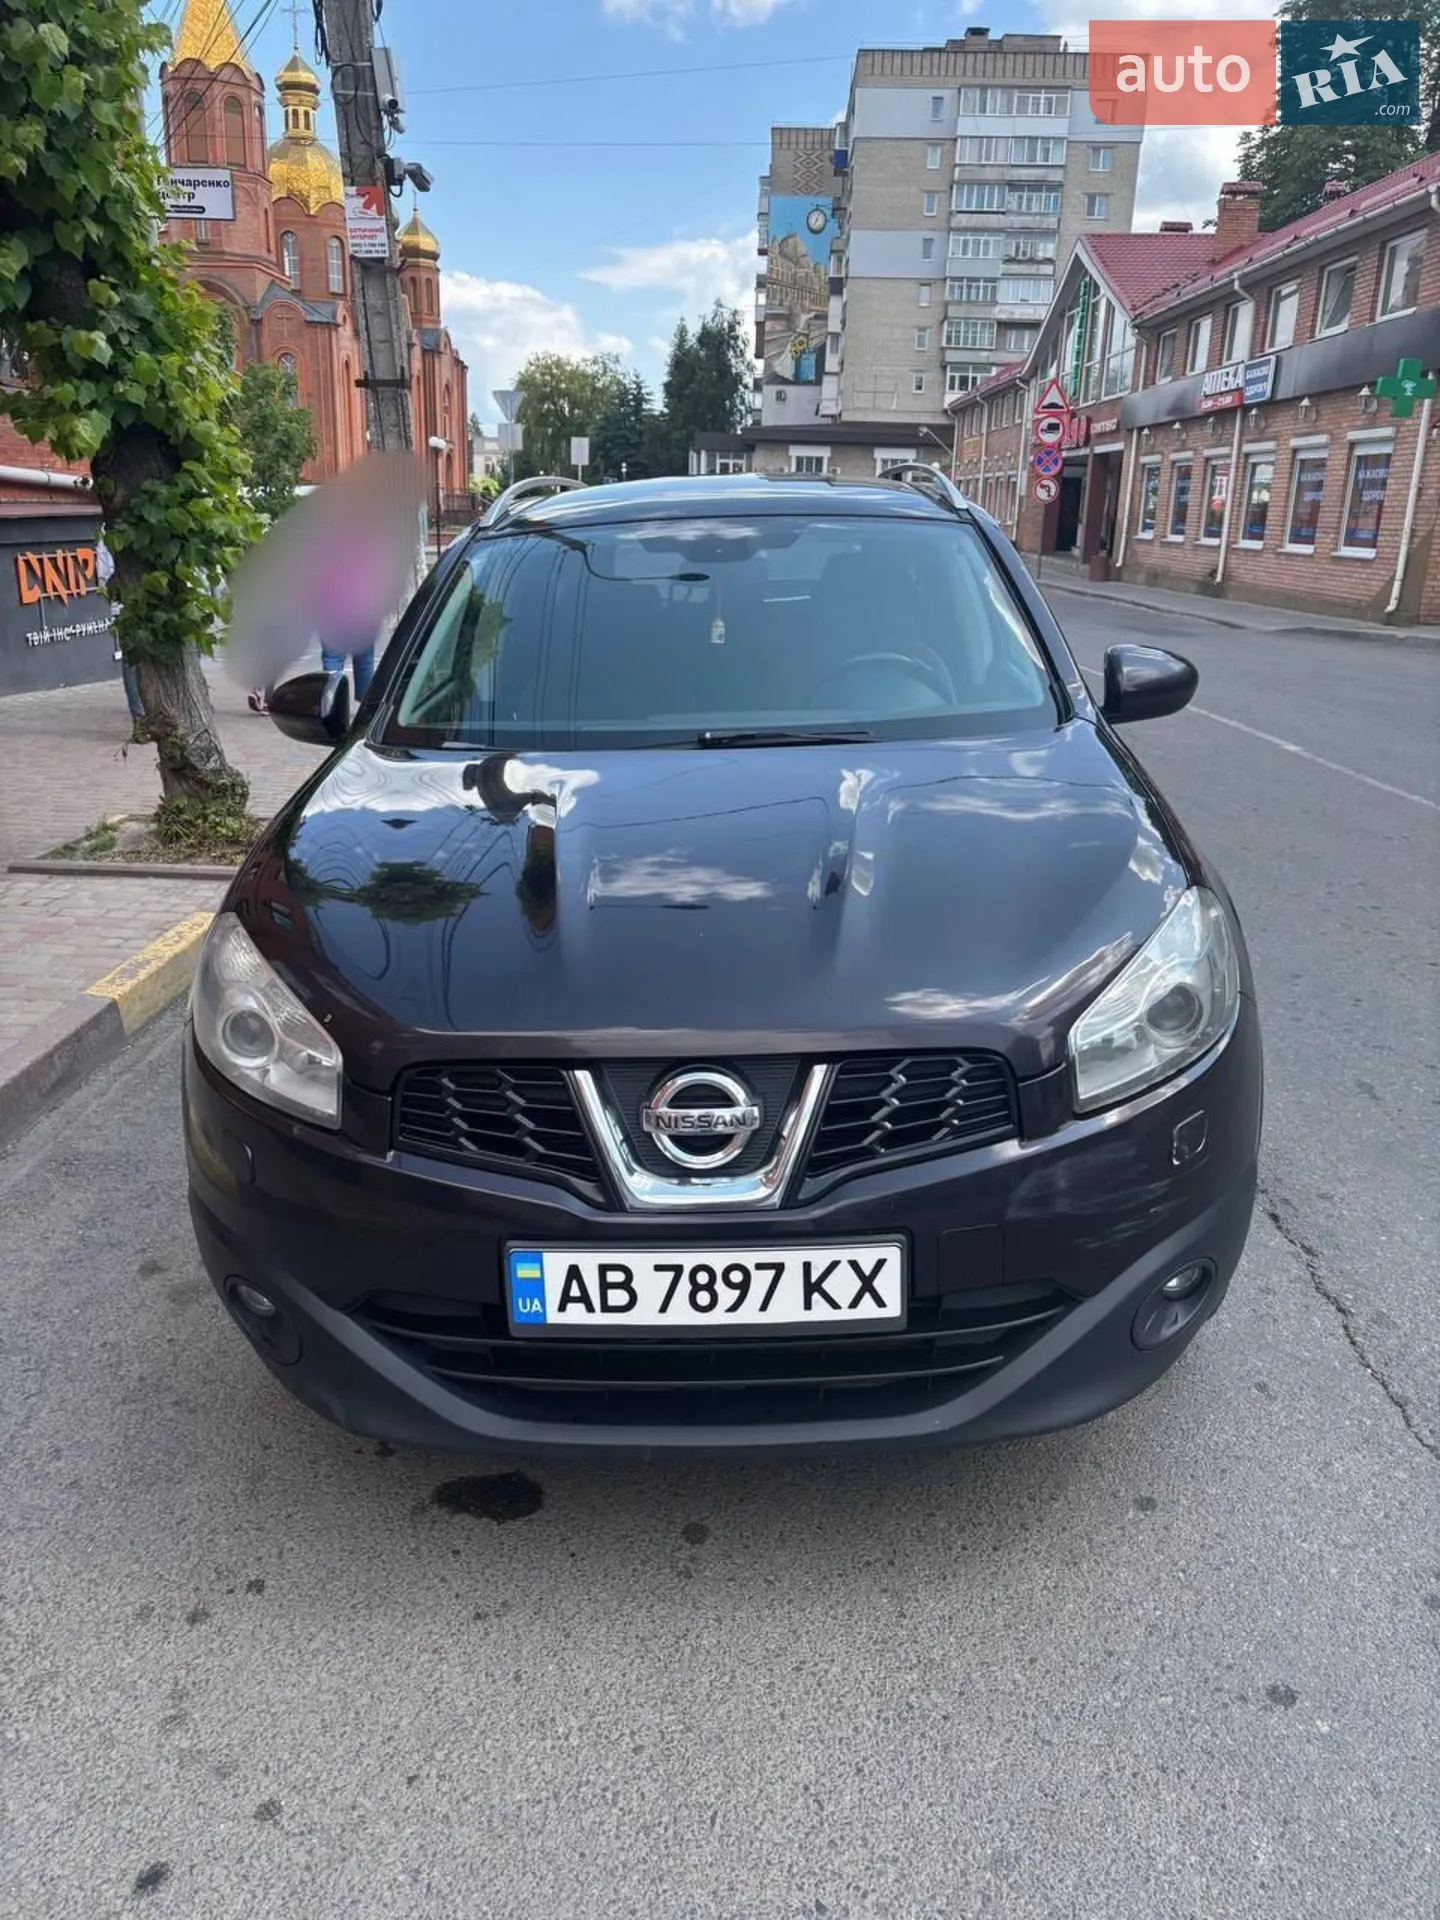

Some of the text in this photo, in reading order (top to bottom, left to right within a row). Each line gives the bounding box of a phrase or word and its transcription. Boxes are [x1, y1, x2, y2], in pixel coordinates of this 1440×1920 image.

[157, 175, 230, 190] Гнчаренко
[1201, 363, 1244, 397] АПТЕКА
[654, 1112, 749, 1130] NISSAN
[556, 1257, 888, 1314] AB 7897 KX
[517, 1298, 543, 1313] UA
